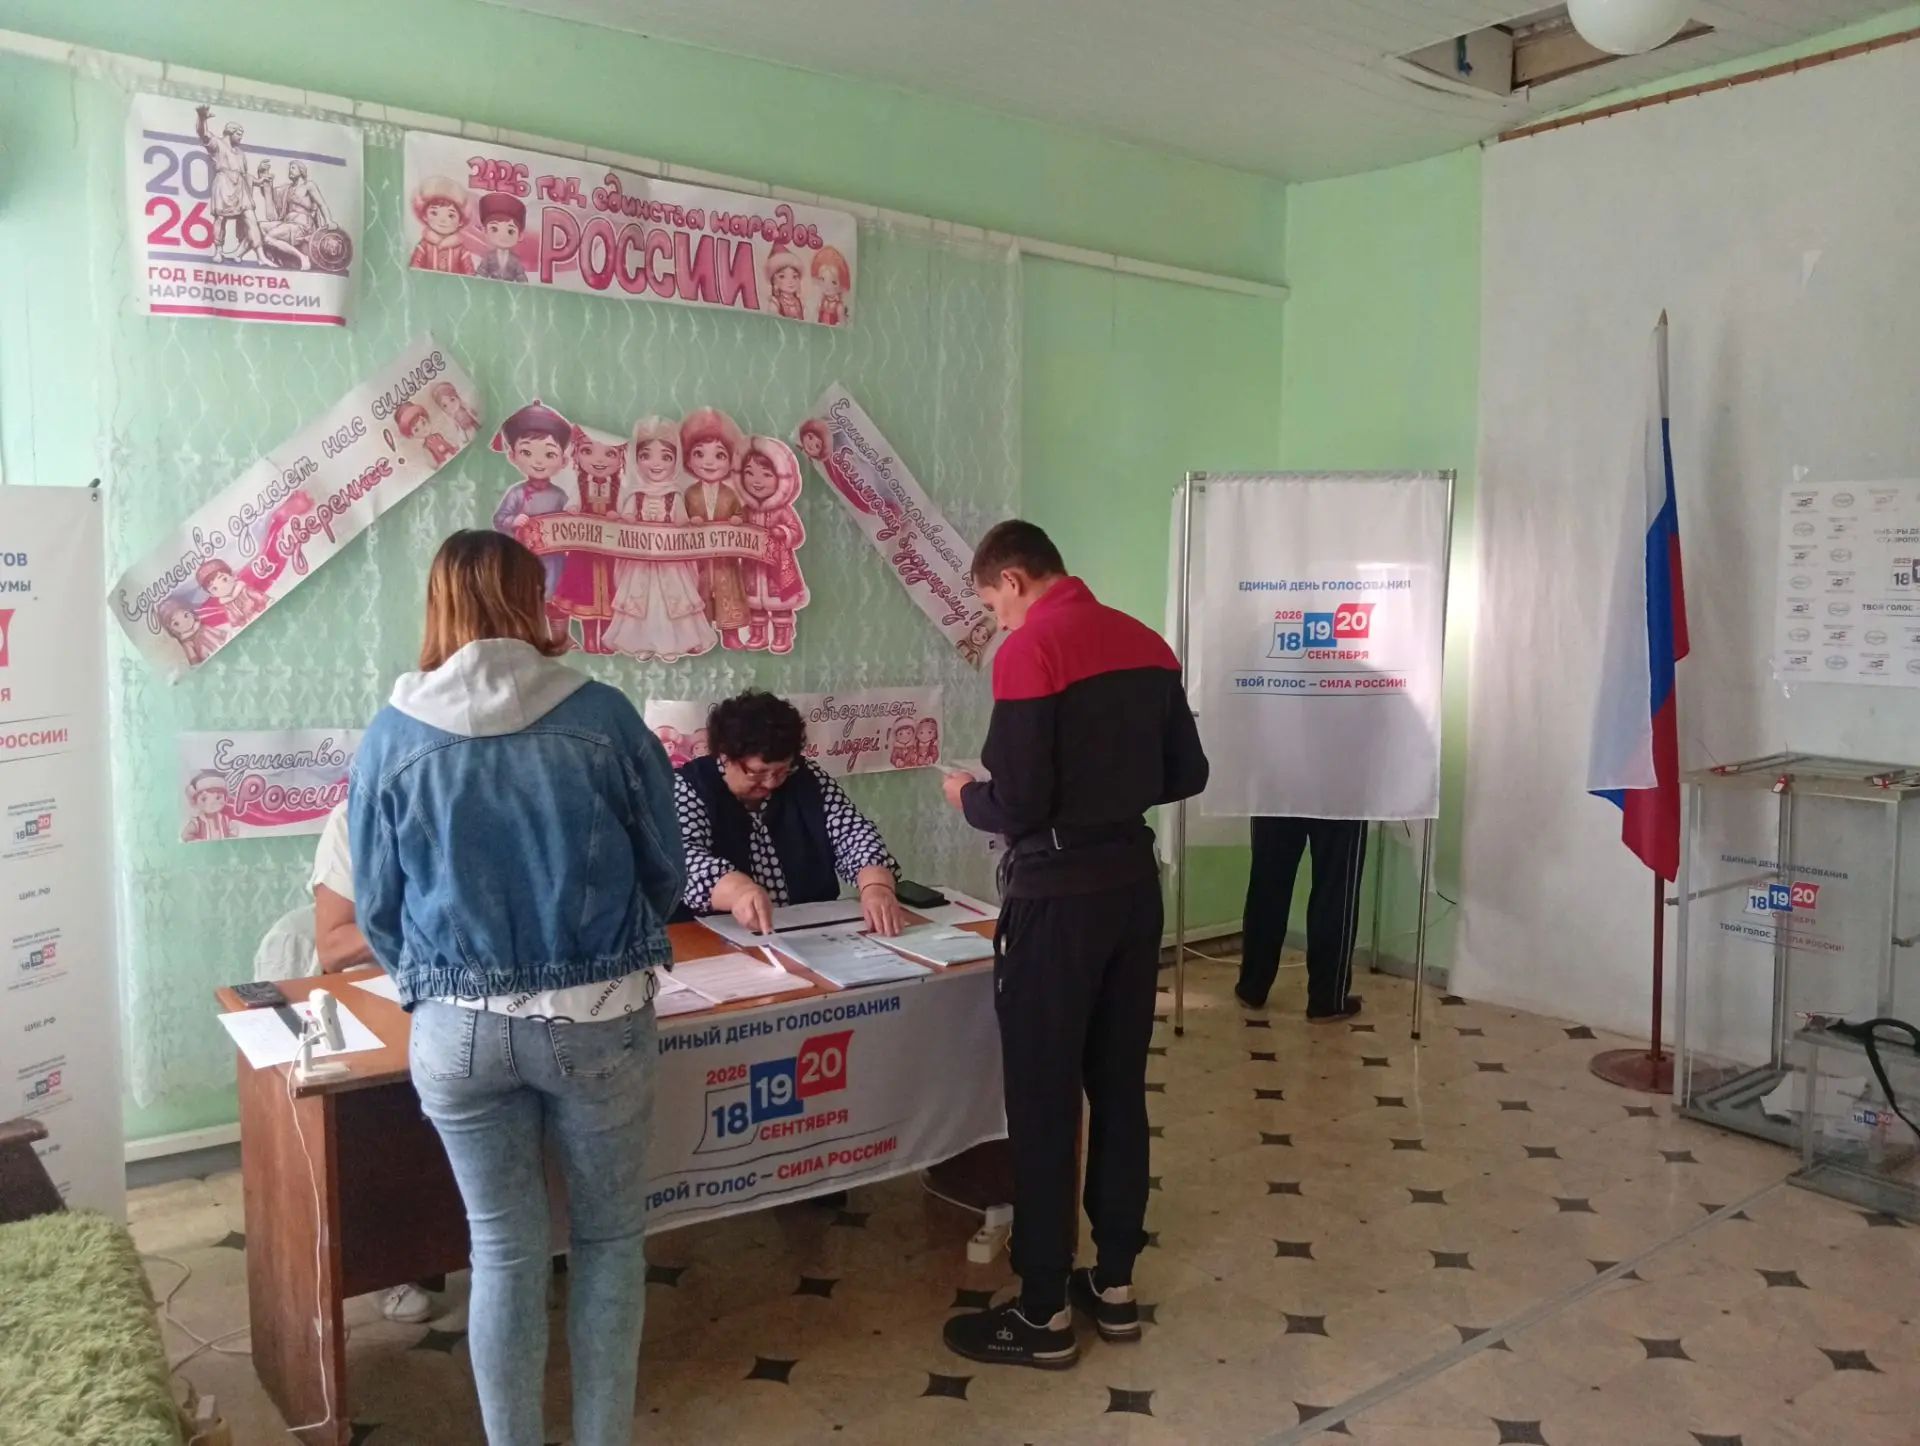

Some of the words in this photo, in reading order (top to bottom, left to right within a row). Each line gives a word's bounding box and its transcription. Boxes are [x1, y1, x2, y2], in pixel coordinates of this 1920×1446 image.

[143, 145, 213, 199] 20
[466, 156, 531, 197] 2026
[709, 203, 824, 249] народов
[145, 196, 216, 249] 26
[540, 207, 760, 310] РОССИИ
[148, 266, 186, 283] ГОД
[193, 268, 290, 290] ЕДИНСТВА
[149, 284, 238, 303] НАРОДОВ
[244, 290, 321, 308] РОССИИ
[120, 527, 226, 635] Единство
[228, 456, 318, 557] делает
[322, 417, 366, 459] нас
[371, 351, 447, 421] сильнее
[830, 398, 892, 480] Единство
[889, 478, 963, 573] открывает
[833, 447, 900, 541] большому
[551, 523, 603, 544] РОССИЯ
[618, 529, 705, 550] МНОГОЛИКАЯ
[710, 530, 760, 550] СТРАНА
[0, 552, 28, 567] ОВ
[253, 557, 275, 580] и
[1239, 579, 1287, 592] ЕДИНЫЙ
[1289, 581, 1320, 592] ДЕНЬ
[1322, 579, 1411, 591] ГОЛОСОВАНИЯ
[1893, 572, 1910, 586] 18
[1275, 611, 1302, 620] 2026
[1277, 632, 1300, 651] 18
[1307, 621, 1331, 640] 19
[1336, 612, 1368, 631] 20
[1308, 650, 1369, 660] СЕНТЯБРЯ
[1235, 676, 1264, 688] ТВОЙ
[1267, 679, 1306, 689] ГОЛОС
[1319, 679, 1351, 689] СИЛА
[1355, 679, 1406, 689] РОССИИ!
[214, 738, 345, 794] Единство
[1721, 854, 1757, 867] ЕДИНЫЙ
[1750, 895, 1767, 910] 18
[1771, 890, 1789, 906] 19
[1793, 887, 1815, 903] 20
[1720, 922, 1742, 933] ТВОЙ
[1743, 927, 1770, 938] ГОЛОС
[590, 977, 624, 1016] CHANEL
[726, 1020, 773, 1044] ДЕНЬ
[776, 996, 901, 1030] ГОЛОСОВАНИЯ
[706, 1064, 747, 1085] 2026
[711, 1102, 749, 1138] 18
[755, 1074, 792, 1108] 19
[801, 1047, 842, 1084] 20
[760, 1108, 849, 1141] СЕНТЯБРЯ
[696, 1172, 757, 1197] ГОЛОС
[777, 1158, 824, 1180] СИЛА
[828, 1136, 898, 1167] РОССИИ!
